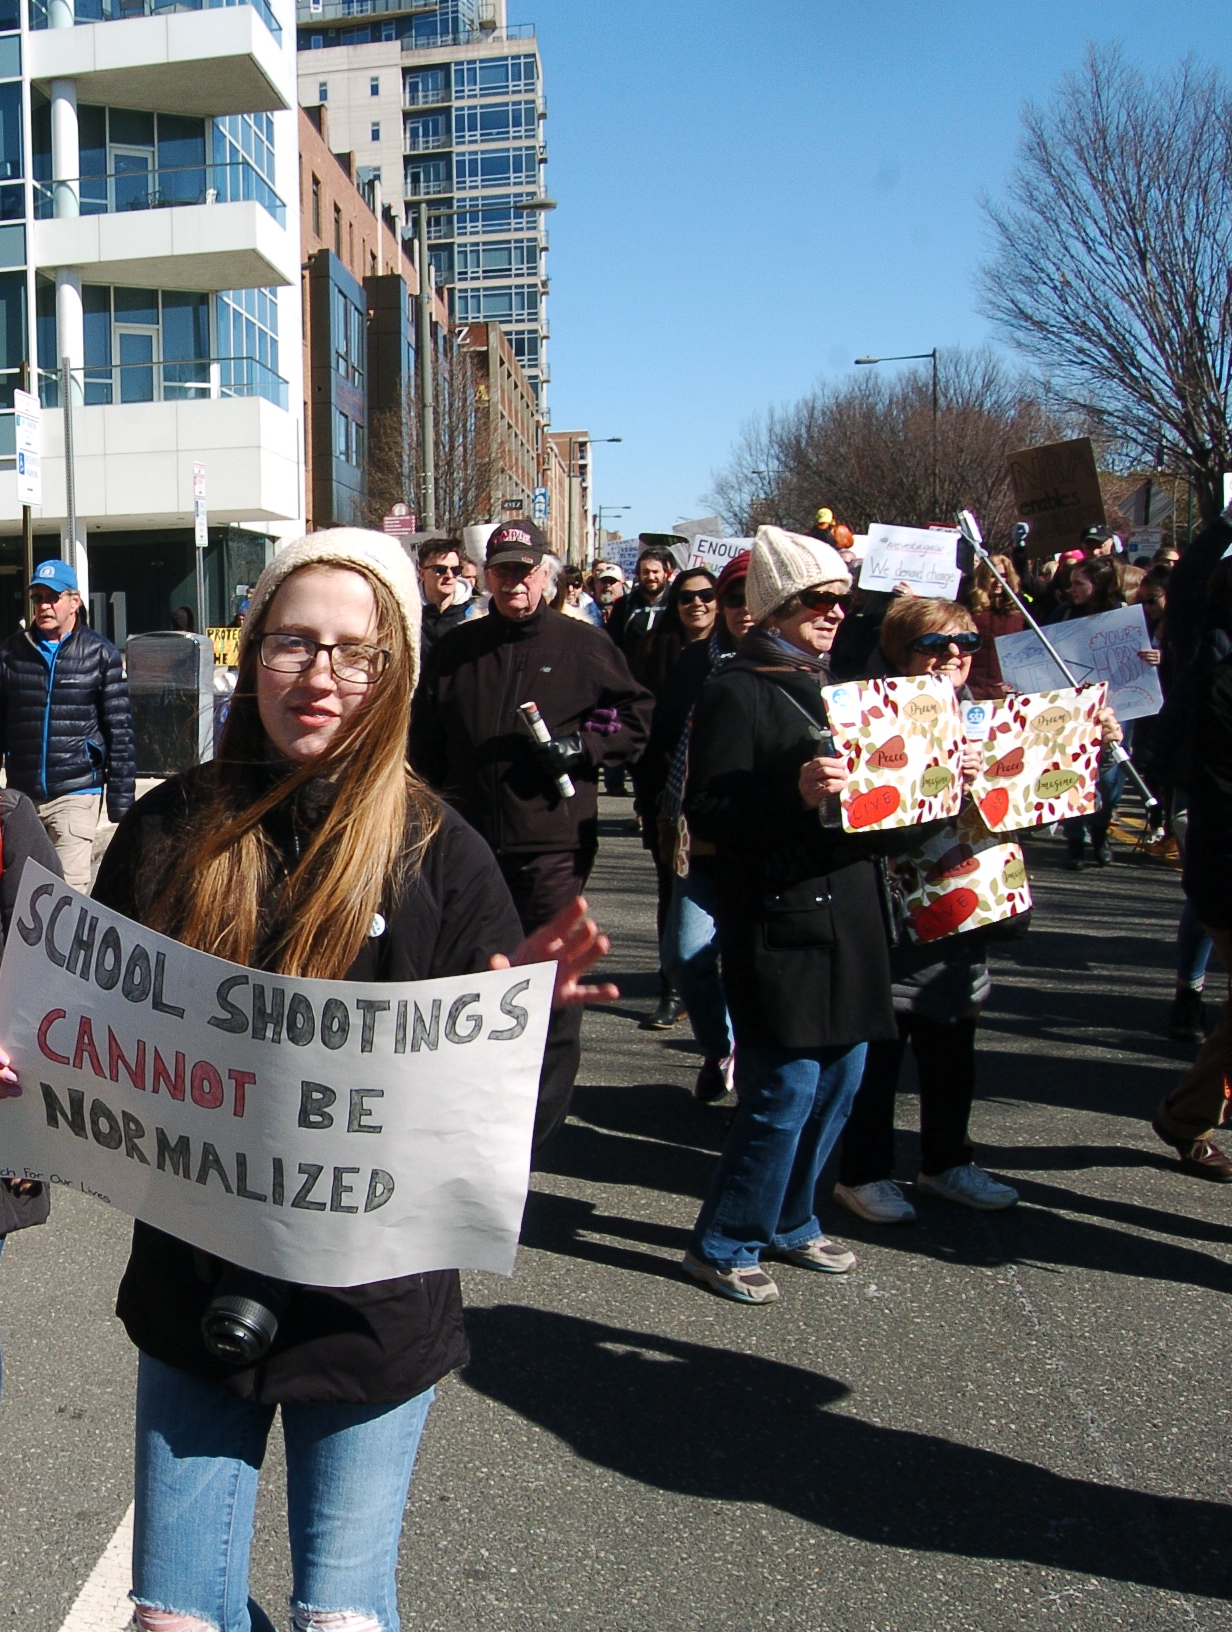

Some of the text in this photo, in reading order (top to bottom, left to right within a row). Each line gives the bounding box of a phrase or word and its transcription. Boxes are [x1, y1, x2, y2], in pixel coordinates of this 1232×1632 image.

[1010, 447, 1093, 493] NRA
[534, 487, 546, 518] PARK
[1020, 487, 1080, 516] enables
[870, 555, 955, 589] We demand change
[1101, 628, 1132, 646] YOUR
[1092, 641, 1145, 686] HOBBY
[909, 701, 938, 716] Dream
[1037, 713, 1066, 727] Dream
[878, 750, 903, 766] Peace
[996, 763, 1019, 776] Peace
[1037, 777, 1073, 792] Imagine
[16, 883, 531, 1055] SCHOOL SHOOTINGS
[36, 1008, 384, 1134] CANNOT BE
[39, 1081, 396, 1214] NORMALIZED
[23, 1167, 44, 1179] For
[49, 1173, 73, 1187] Our
[80, 1181, 112, 1204] Lives
